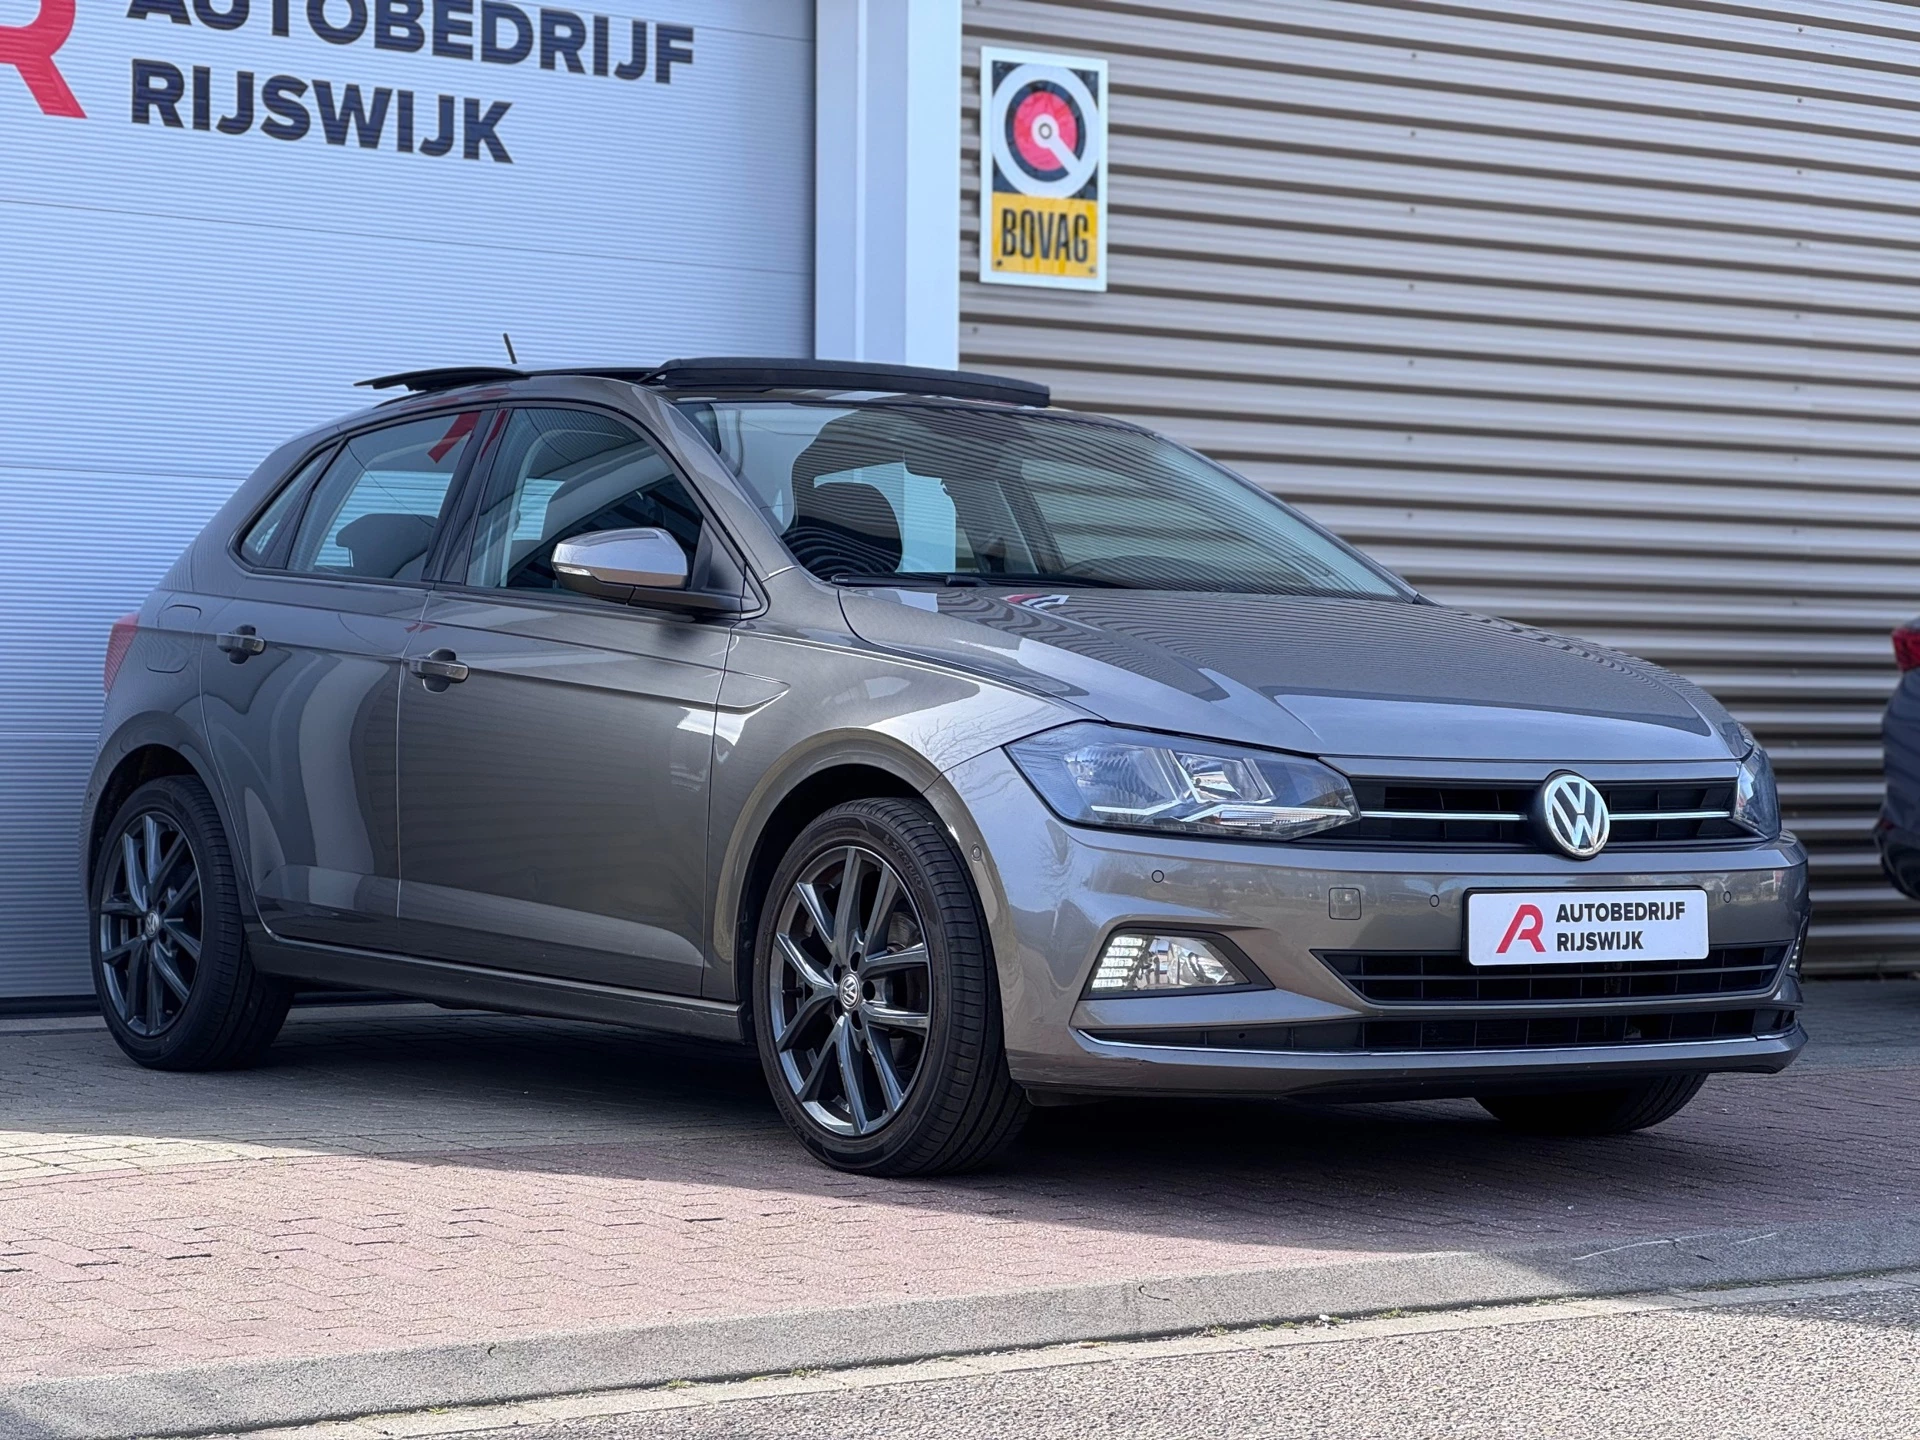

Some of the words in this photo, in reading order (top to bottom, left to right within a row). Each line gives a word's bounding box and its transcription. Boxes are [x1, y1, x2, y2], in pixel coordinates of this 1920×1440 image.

[132, 58, 516, 164] RIJSWIJK
[1002, 208, 1089, 263] BOVAG
[1556, 901, 1686, 923] AUTOBEDRIJF
[1556, 931, 1644, 952] RIJSWIJK
